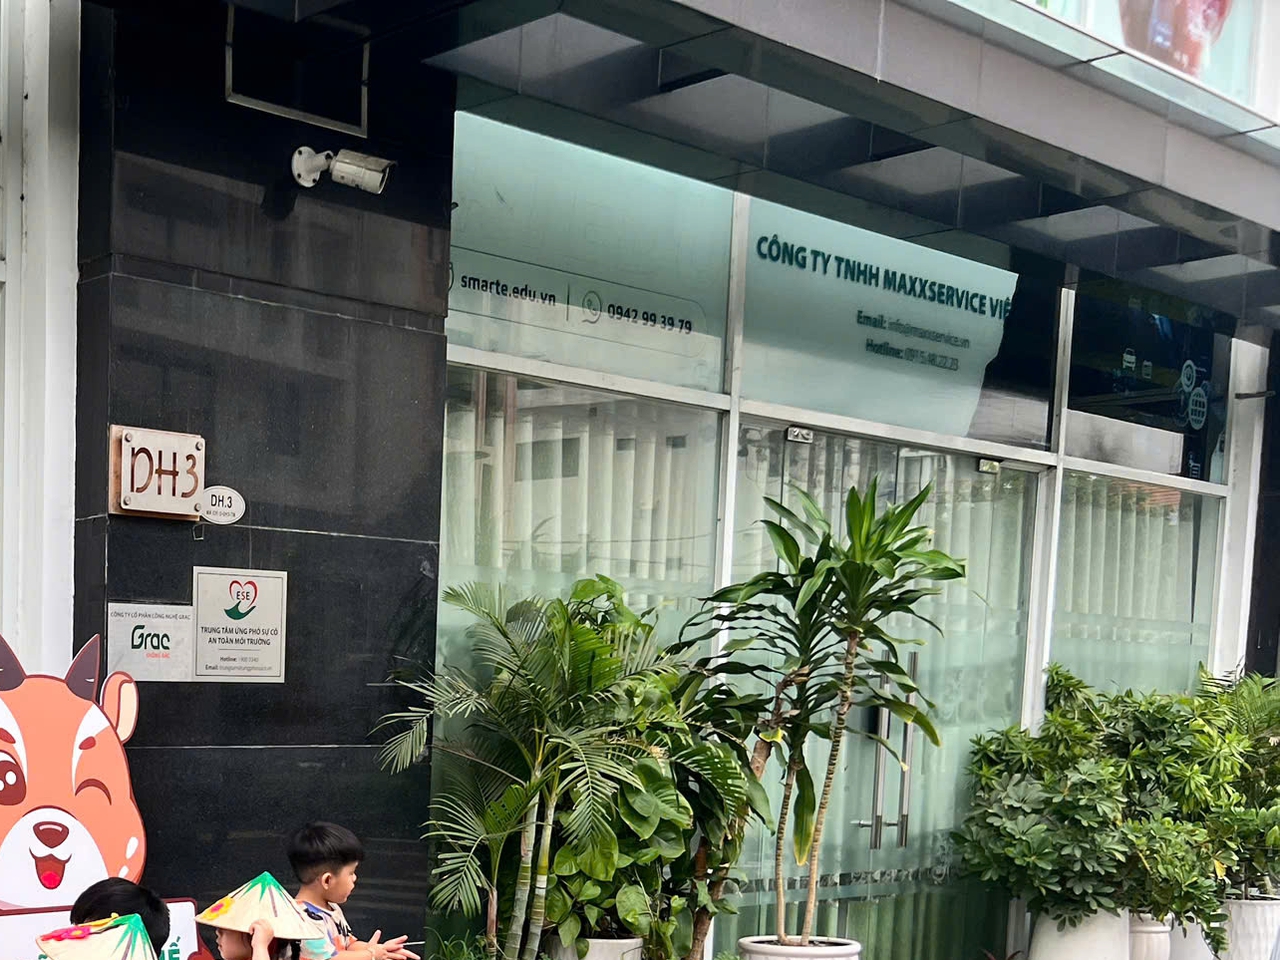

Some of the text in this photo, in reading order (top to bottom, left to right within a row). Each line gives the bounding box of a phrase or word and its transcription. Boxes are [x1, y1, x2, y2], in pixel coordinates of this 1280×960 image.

[756, 234, 807, 269] CÔNG
[810, 249, 832, 275] TY
[834, 255, 880, 288] TNHH
[882, 269, 986, 315] MAXXSERVICE
[461, 273, 692, 335] smarte.edu.vn 0942 99 39 79
[856, 310, 886, 330] Email:
[130, 446, 200, 499] DH3
[210, 494, 233, 509] DH.3
[236, 590, 251, 601] ESE
[131, 624, 171, 650] Grac
[200, 626, 221, 634] TRUNG
